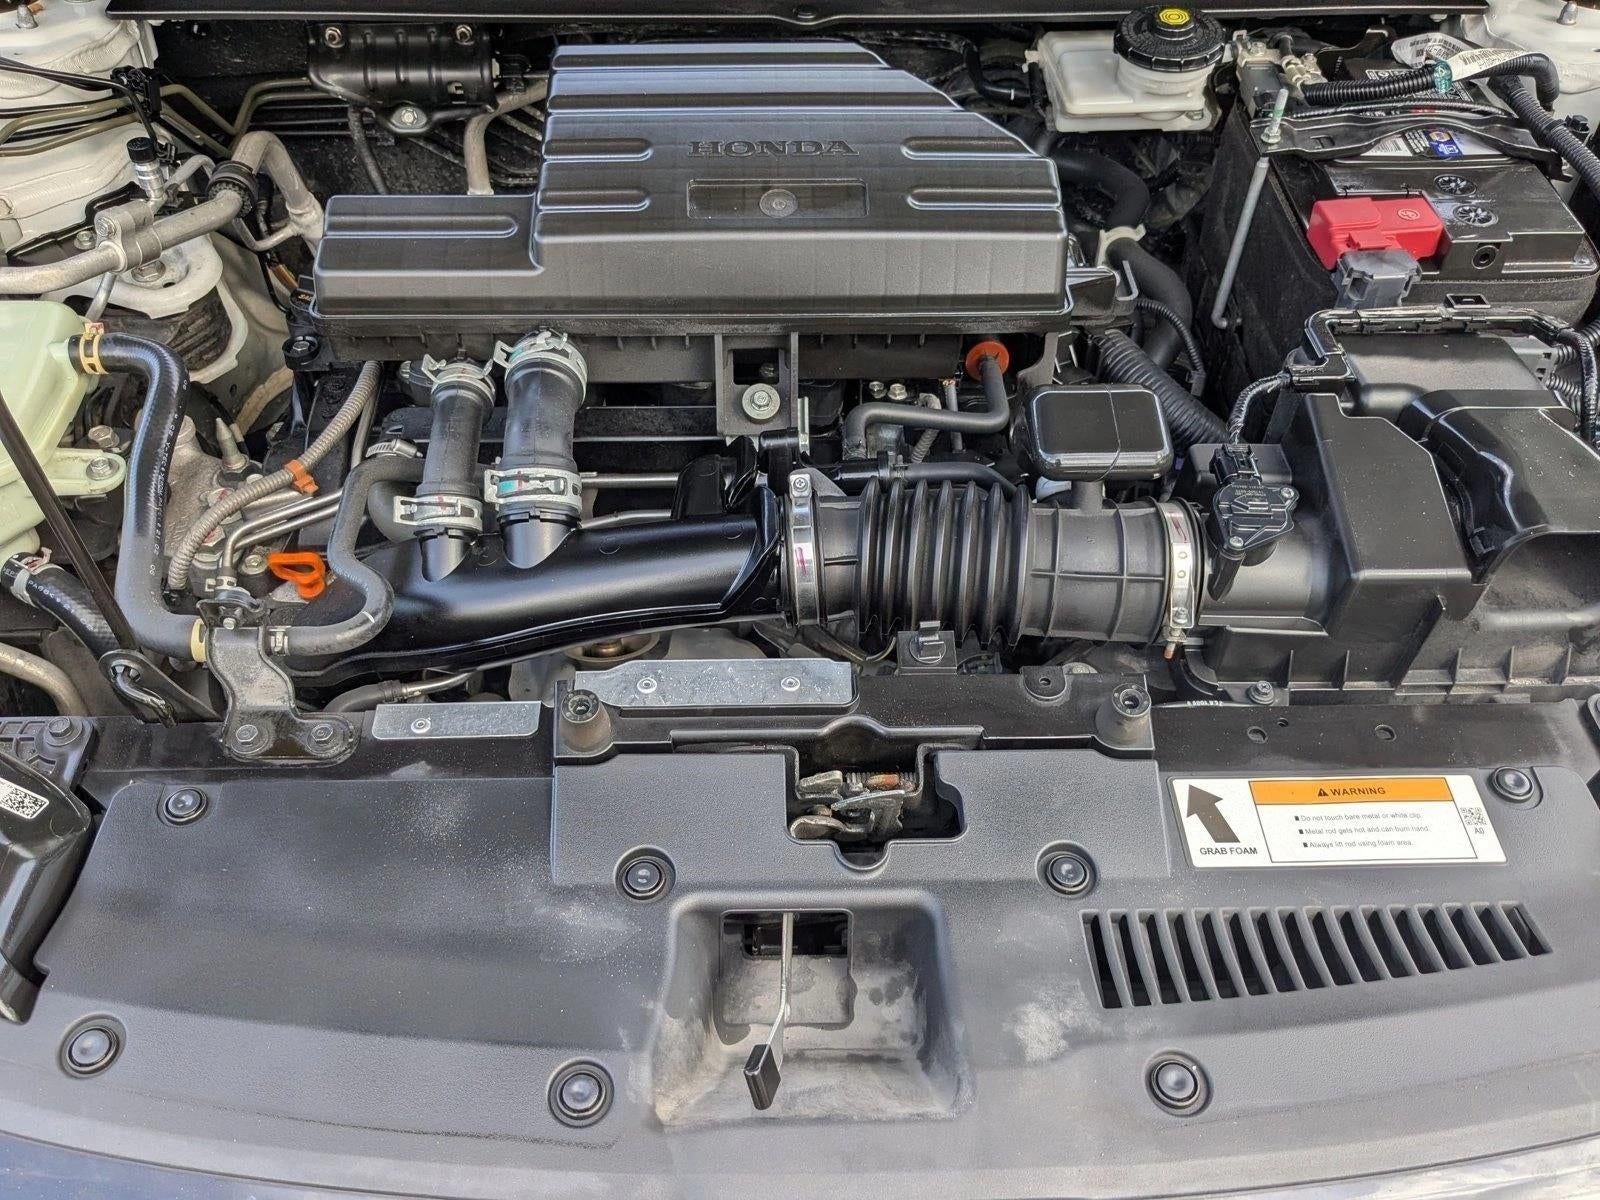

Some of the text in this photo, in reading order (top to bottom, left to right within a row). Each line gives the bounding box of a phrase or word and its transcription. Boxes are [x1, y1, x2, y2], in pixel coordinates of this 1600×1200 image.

[687, 140, 860, 158] HONDA
[1330, 787, 1386, 796] WARNING
[1309, 841, 1334, 849] Always
[1200, 847, 1258, 855] GRAB FOAM
